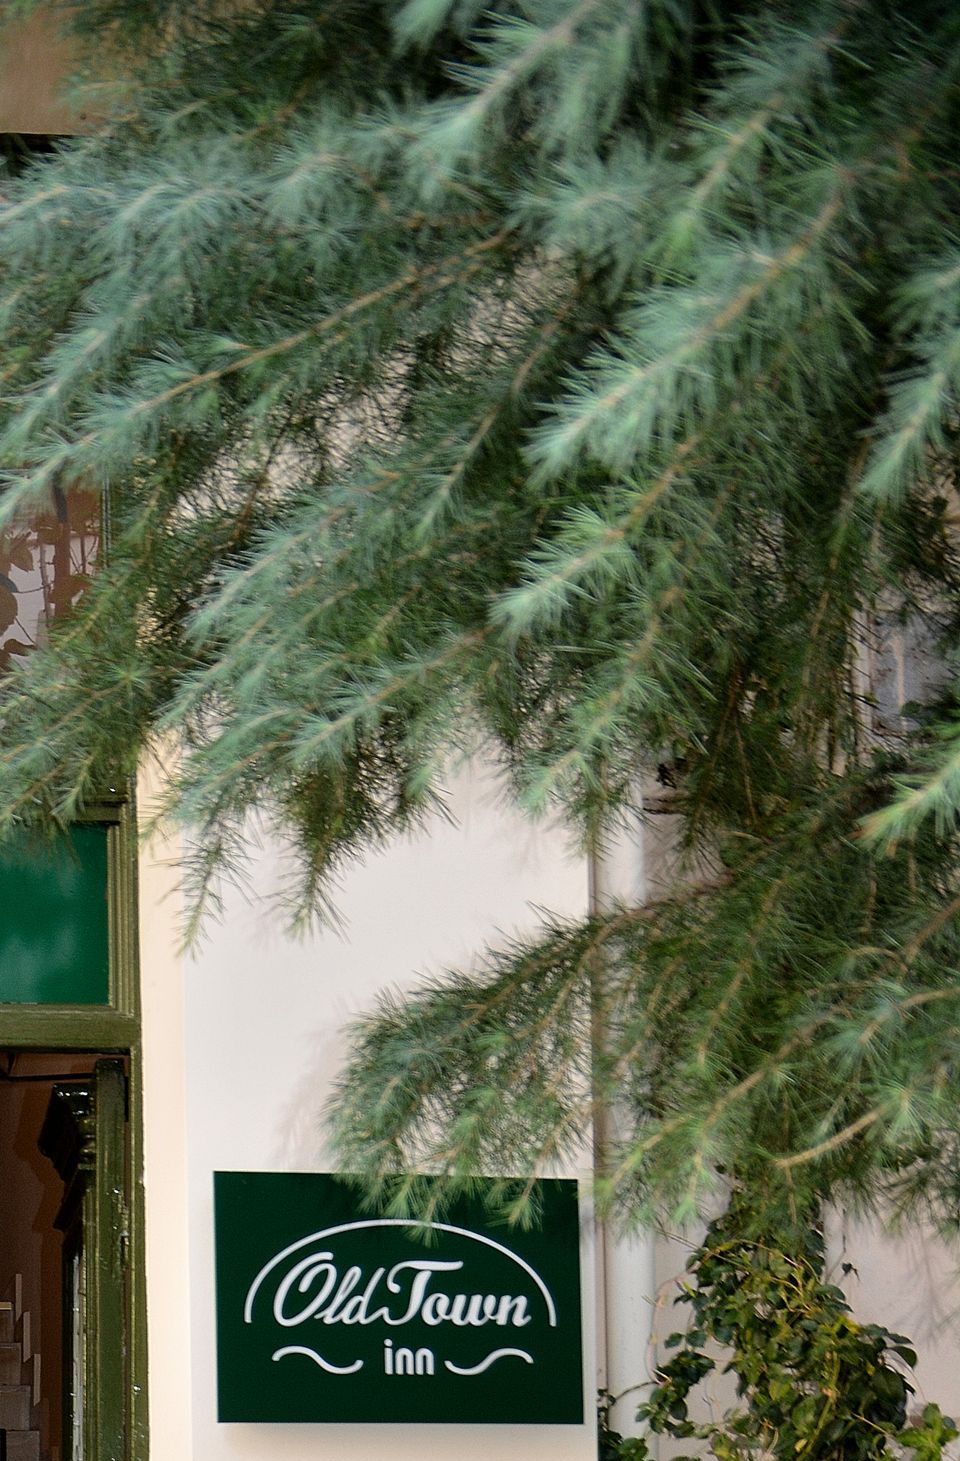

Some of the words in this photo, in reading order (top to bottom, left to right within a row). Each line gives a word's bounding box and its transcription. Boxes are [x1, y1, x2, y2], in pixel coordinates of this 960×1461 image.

[273, 1251, 386, 1327] Old
[383, 1260, 532, 1327] Town
[383, 1338, 435, 1376] inn
